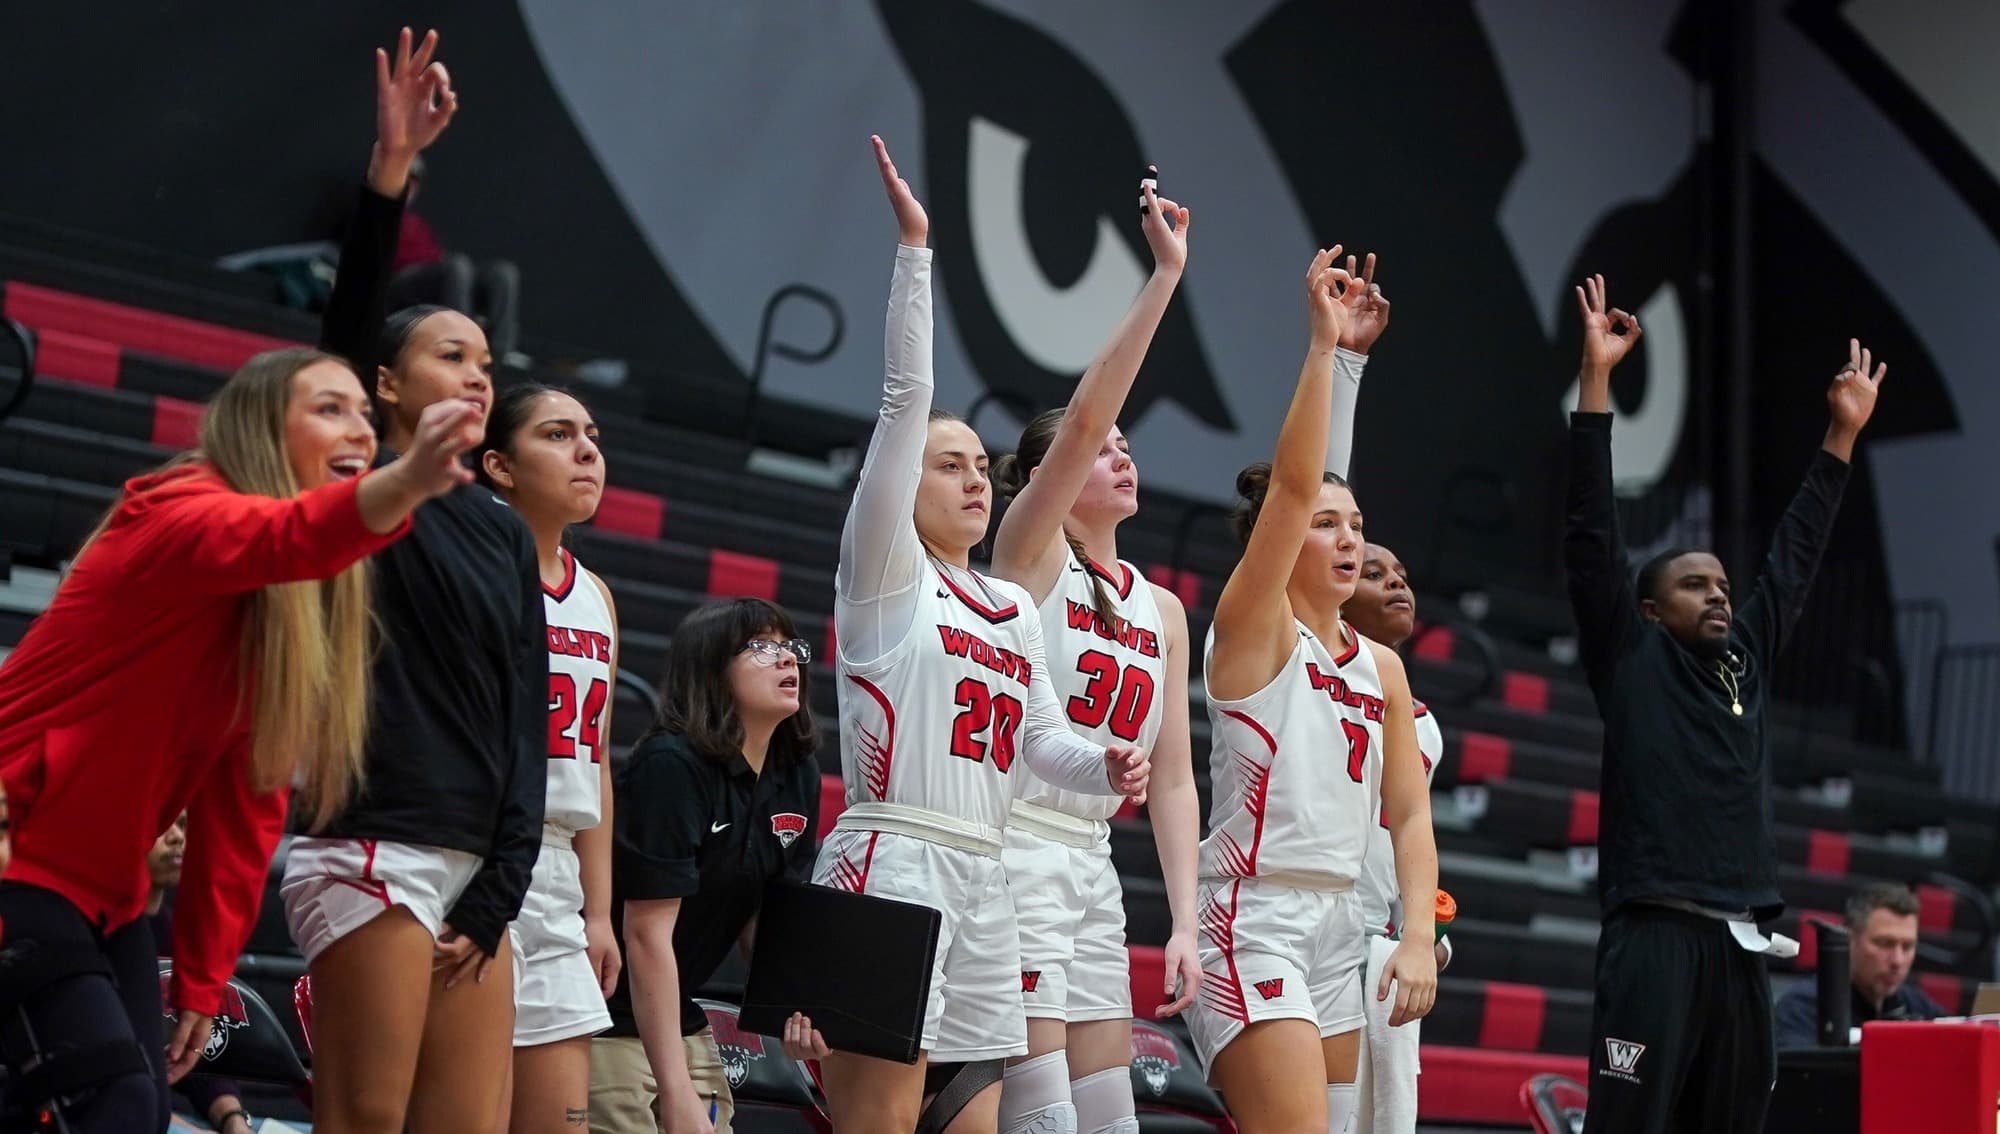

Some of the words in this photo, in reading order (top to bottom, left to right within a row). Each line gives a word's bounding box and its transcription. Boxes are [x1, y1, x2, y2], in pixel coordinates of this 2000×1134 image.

[546, 624, 611, 664] OLVE
[936, 624, 1032, 688] WOLVE
[1066, 597, 1162, 660] WOLVE
[548, 671, 607, 763] 24
[950, 677, 1023, 774] 20
[1066, 649, 1155, 742] 30
[1253, 977, 1284, 1000] W
[1605, 1037, 1646, 1074] W
